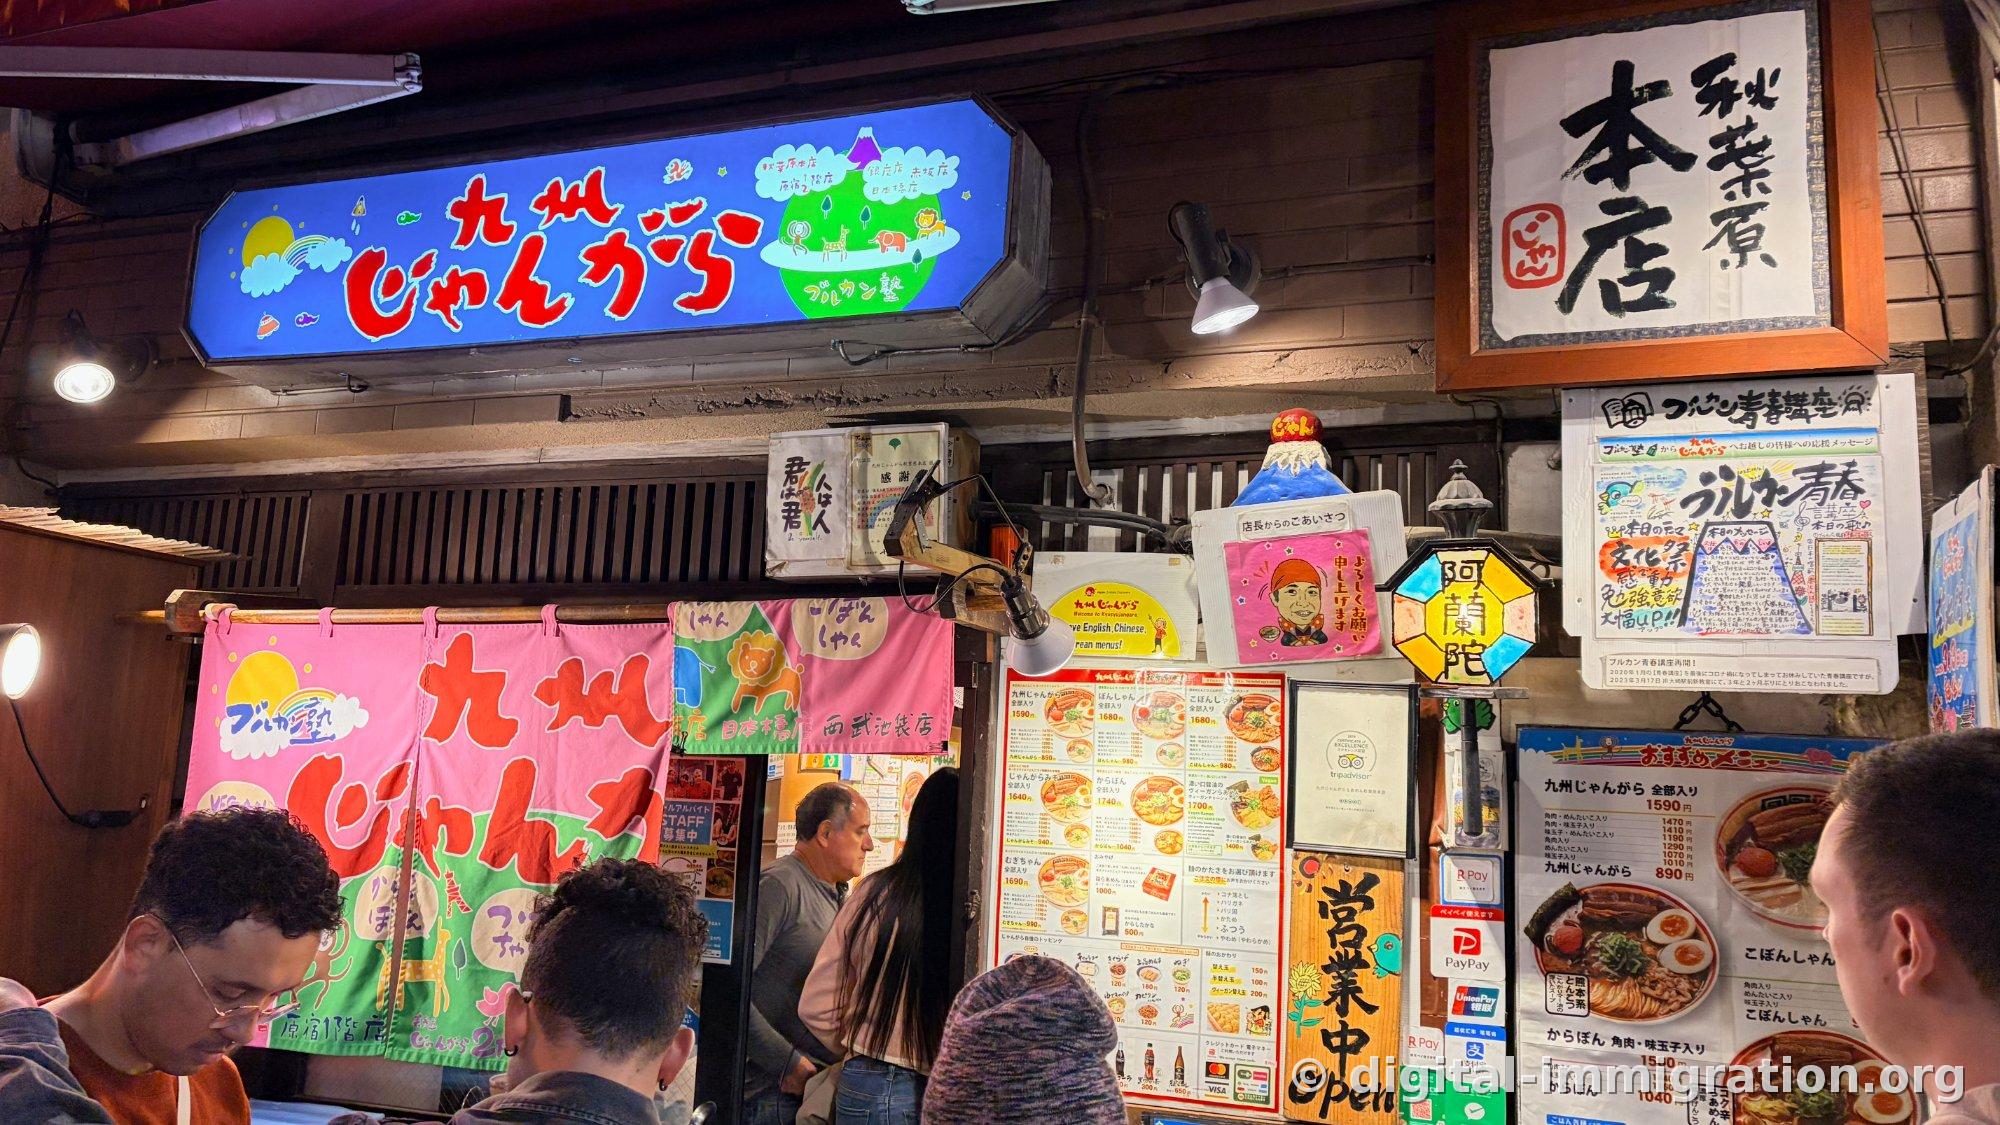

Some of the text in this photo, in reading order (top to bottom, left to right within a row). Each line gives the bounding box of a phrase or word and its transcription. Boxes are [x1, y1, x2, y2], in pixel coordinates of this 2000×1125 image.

[1691, 51, 1781, 270] 秋葉原
[1555, 60, 1698, 318] 本店
[446, 166, 624, 250] 九州
[1511, 211, 1557, 279] じゃん
[343, 197, 764, 342] じゃんがら
[804, 272, 905, 306] ブルカン塾
[1271, 416, 1314, 437] じゃん
[780, 456, 811, 533] 君は君
[812, 473, 833, 534] 人は人
[1242, 511, 1347, 532] 店長からのごあいさつ
[1610, 537, 1691, 573] 文化祭
[1334, 555, 1349, 632] 申し上げます
[1350, 555, 1366, 642] よろしくお願い
[690, 610, 729, 632] しゃん
[1441, 559, 1487, 680] 阿蘭陀
[818, 625, 863, 650] しゃん
[1095, 639, 1122, 650] menus!
[418, 630, 673, 750] 九州
[226, 696, 336, 745] ブルカン塾
[822, 711, 935, 738] 西武池袋店
[1639, 742, 1783, 769] おすすめメニュー
[1330, 771, 1370, 780] tripadvisor
[1545, 778, 1698, 797] 九州じゃんがら 全部入り
[662, 814, 706, 828] STAFF
[663, 827, 699, 843] 募集中
[1467, 870, 1488, 883] Pay
[1545, 860, 1632, 877] 九州じゃんがら
[1445, 957, 1490, 972] PayPay
[1744, 947, 1836, 967] こぼんしゃん
[1317, 872, 1380, 1078] 営業中
[1456, 992, 1497, 1006] UnionPay
[1565, 976, 1575, 1009] とんこつ
[1575, 976, 1587, 1010] 熊本系
[1743, 990, 1793, 1001] めんたいこ入り
[1745, 1008, 1827, 1027] こぼんしゃん
[1418, 1037, 1440, 1051] Pay
[1546, 1028, 1705, 1055] からぼん 角肉・味玉子入り
[1208, 1086, 1227, 1094] VISA
